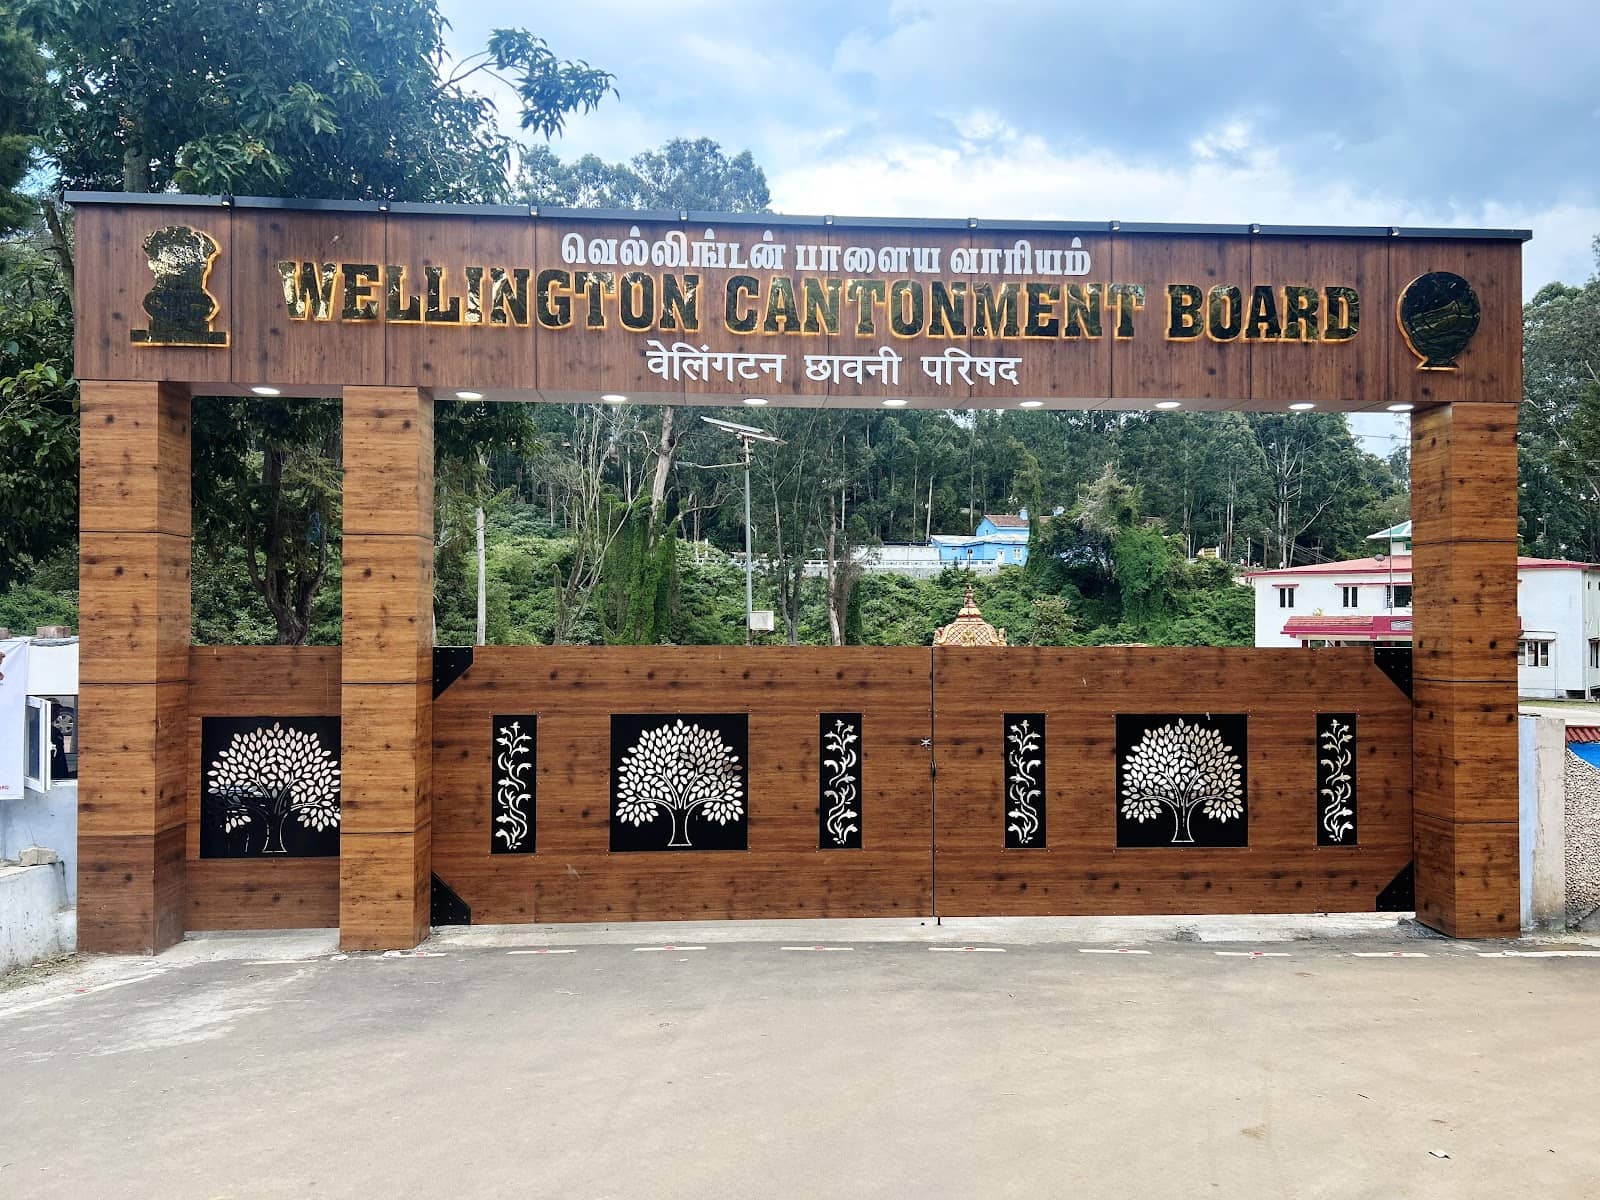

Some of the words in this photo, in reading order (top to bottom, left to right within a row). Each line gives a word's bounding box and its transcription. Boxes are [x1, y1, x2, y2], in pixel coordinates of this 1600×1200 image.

[561, 225, 786, 269] வெல்லிங்டன்
[795, 244, 941, 274] பாளைய
[950, 236, 1091, 276] வாரியம்
[277, 260, 701, 333] WELLINGTON
[724, 274, 1147, 339] CANTONMENT
[1165, 283, 1361, 343] BOARD
[645, 339, 787, 383] वेलिंगटन
[803, 345, 902, 386] छावनी
[919, 347, 1023, 386] परिषद
